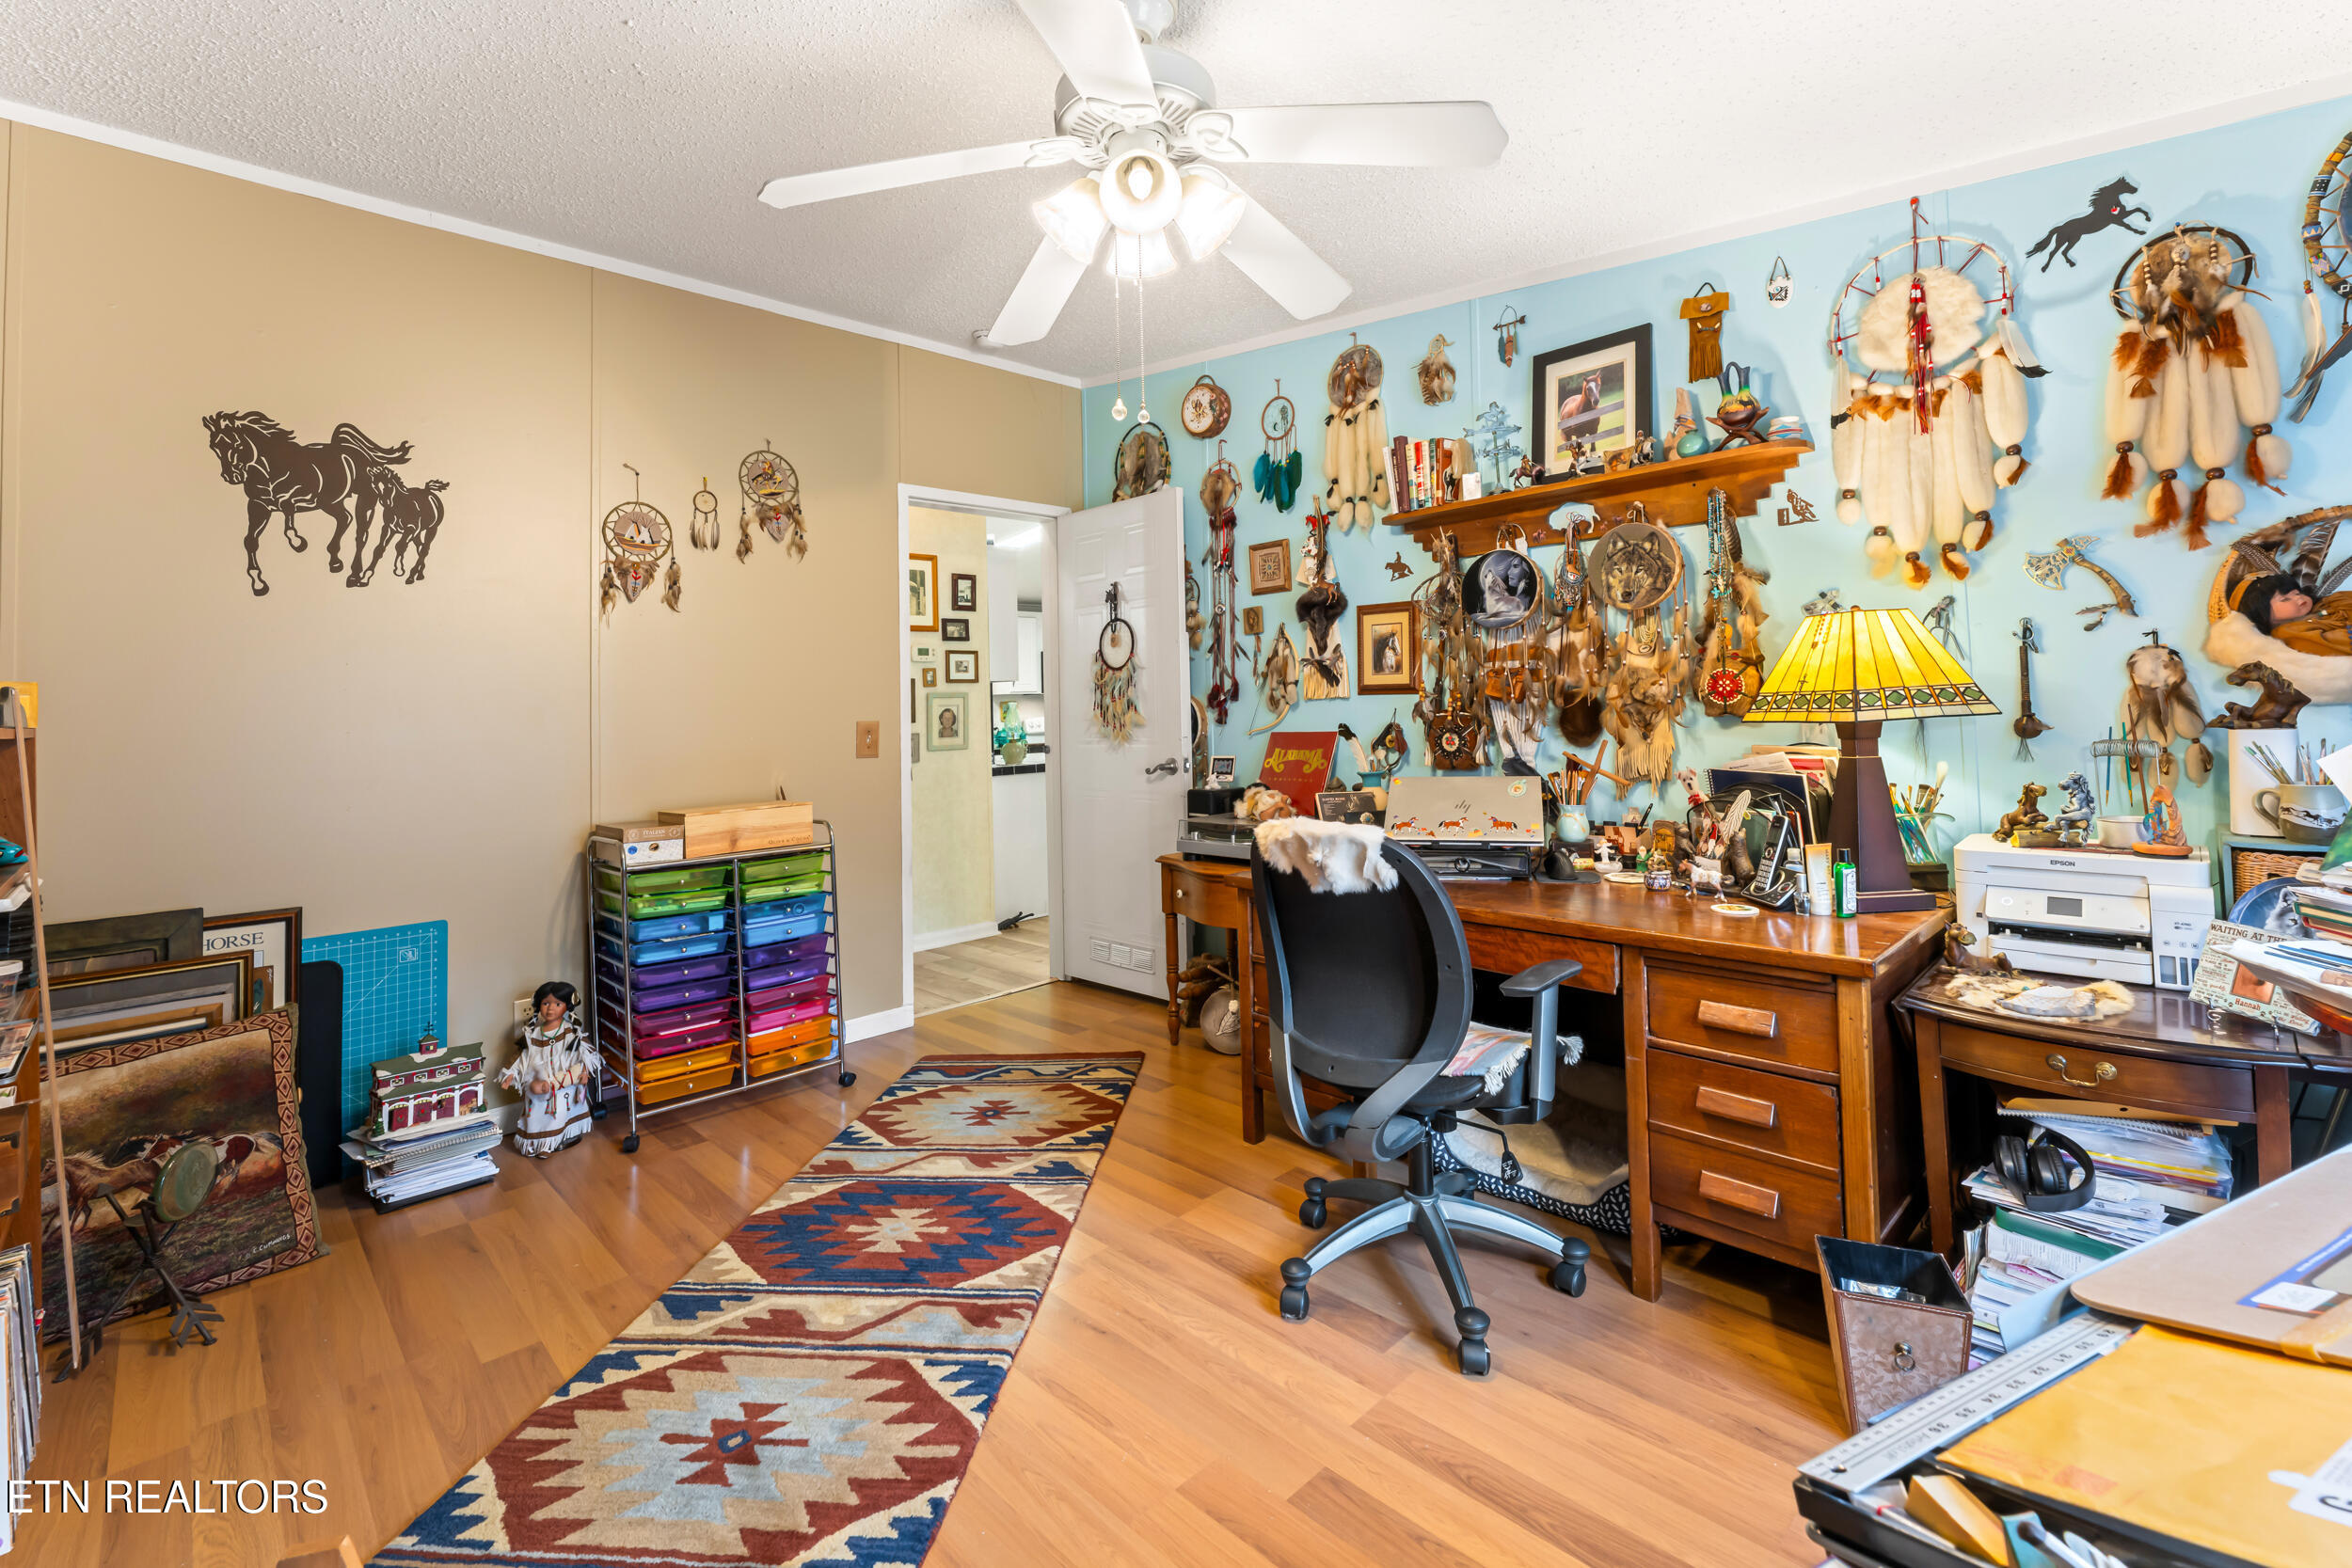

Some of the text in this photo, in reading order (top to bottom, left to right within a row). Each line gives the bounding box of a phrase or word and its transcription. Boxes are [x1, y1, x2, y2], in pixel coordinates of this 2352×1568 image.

[1263, 748, 1327, 773] ALABAMA
[2211, 923, 2249, 938] WAITING
[2249, 932, 2265, 942] AT
[2234, 997, 2261, 1010] Hannah
